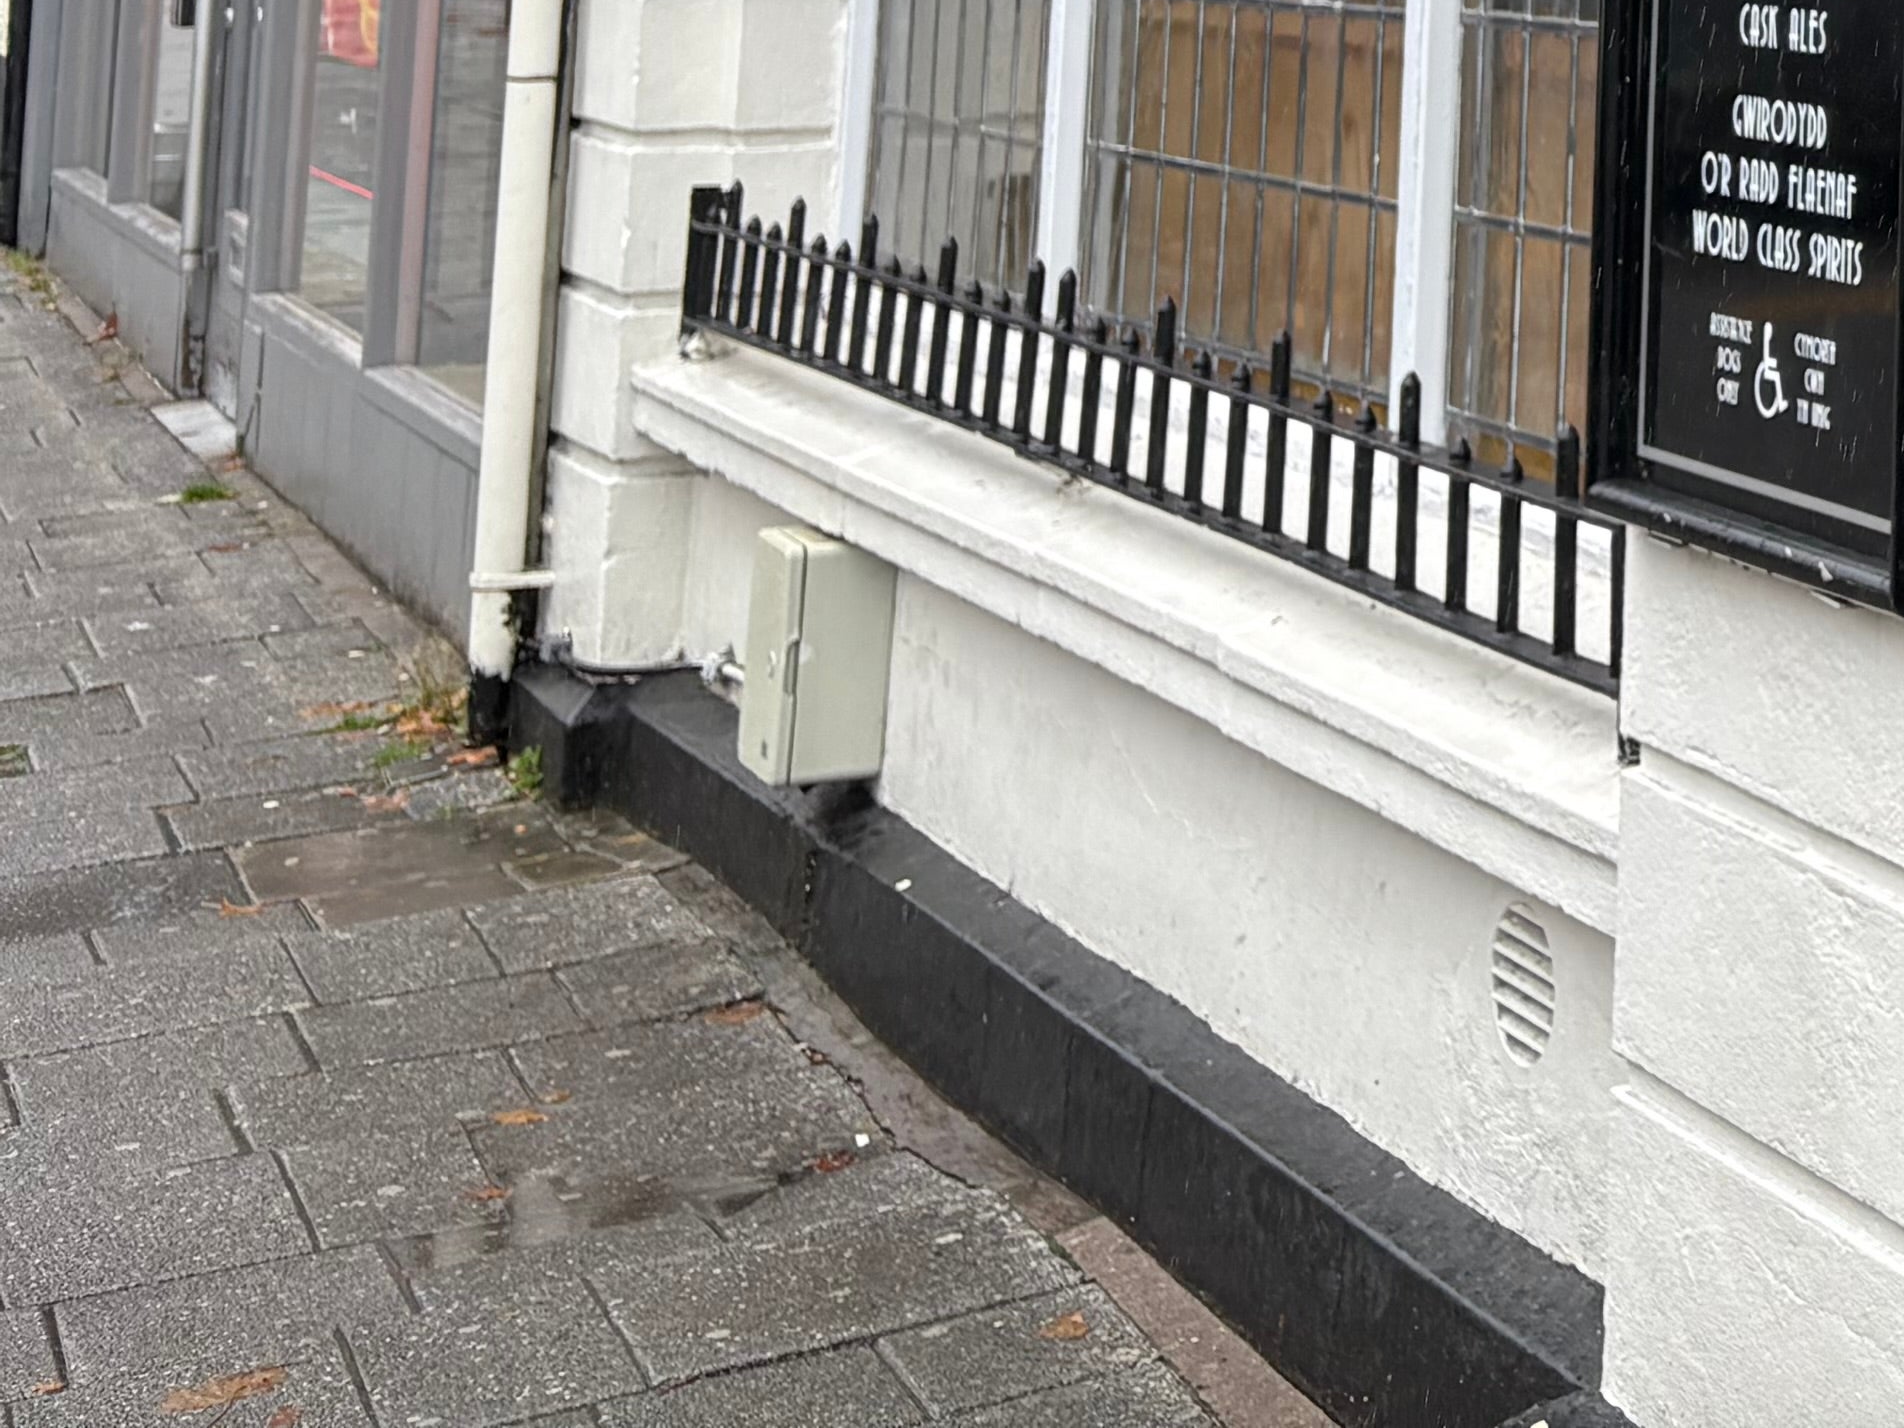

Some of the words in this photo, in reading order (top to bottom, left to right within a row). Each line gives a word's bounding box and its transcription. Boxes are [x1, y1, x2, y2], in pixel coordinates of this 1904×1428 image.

[1739, 3, 1779, 49] CASK
[1788, 7, 1828, 54] ALES
[1732, 94, 1828, 149] GWIRODYDD
[1701, 150, 1731, 197] O'R
[1738, 161, 1779, 204] RADD
[1787, 166, 1857, 220] FLAENAF
[1692, 209, 1749, 261] WORLD
[1756, 228, 1801, 272] CLASS
[1807, 234, 1863, 286] SPIRITS
